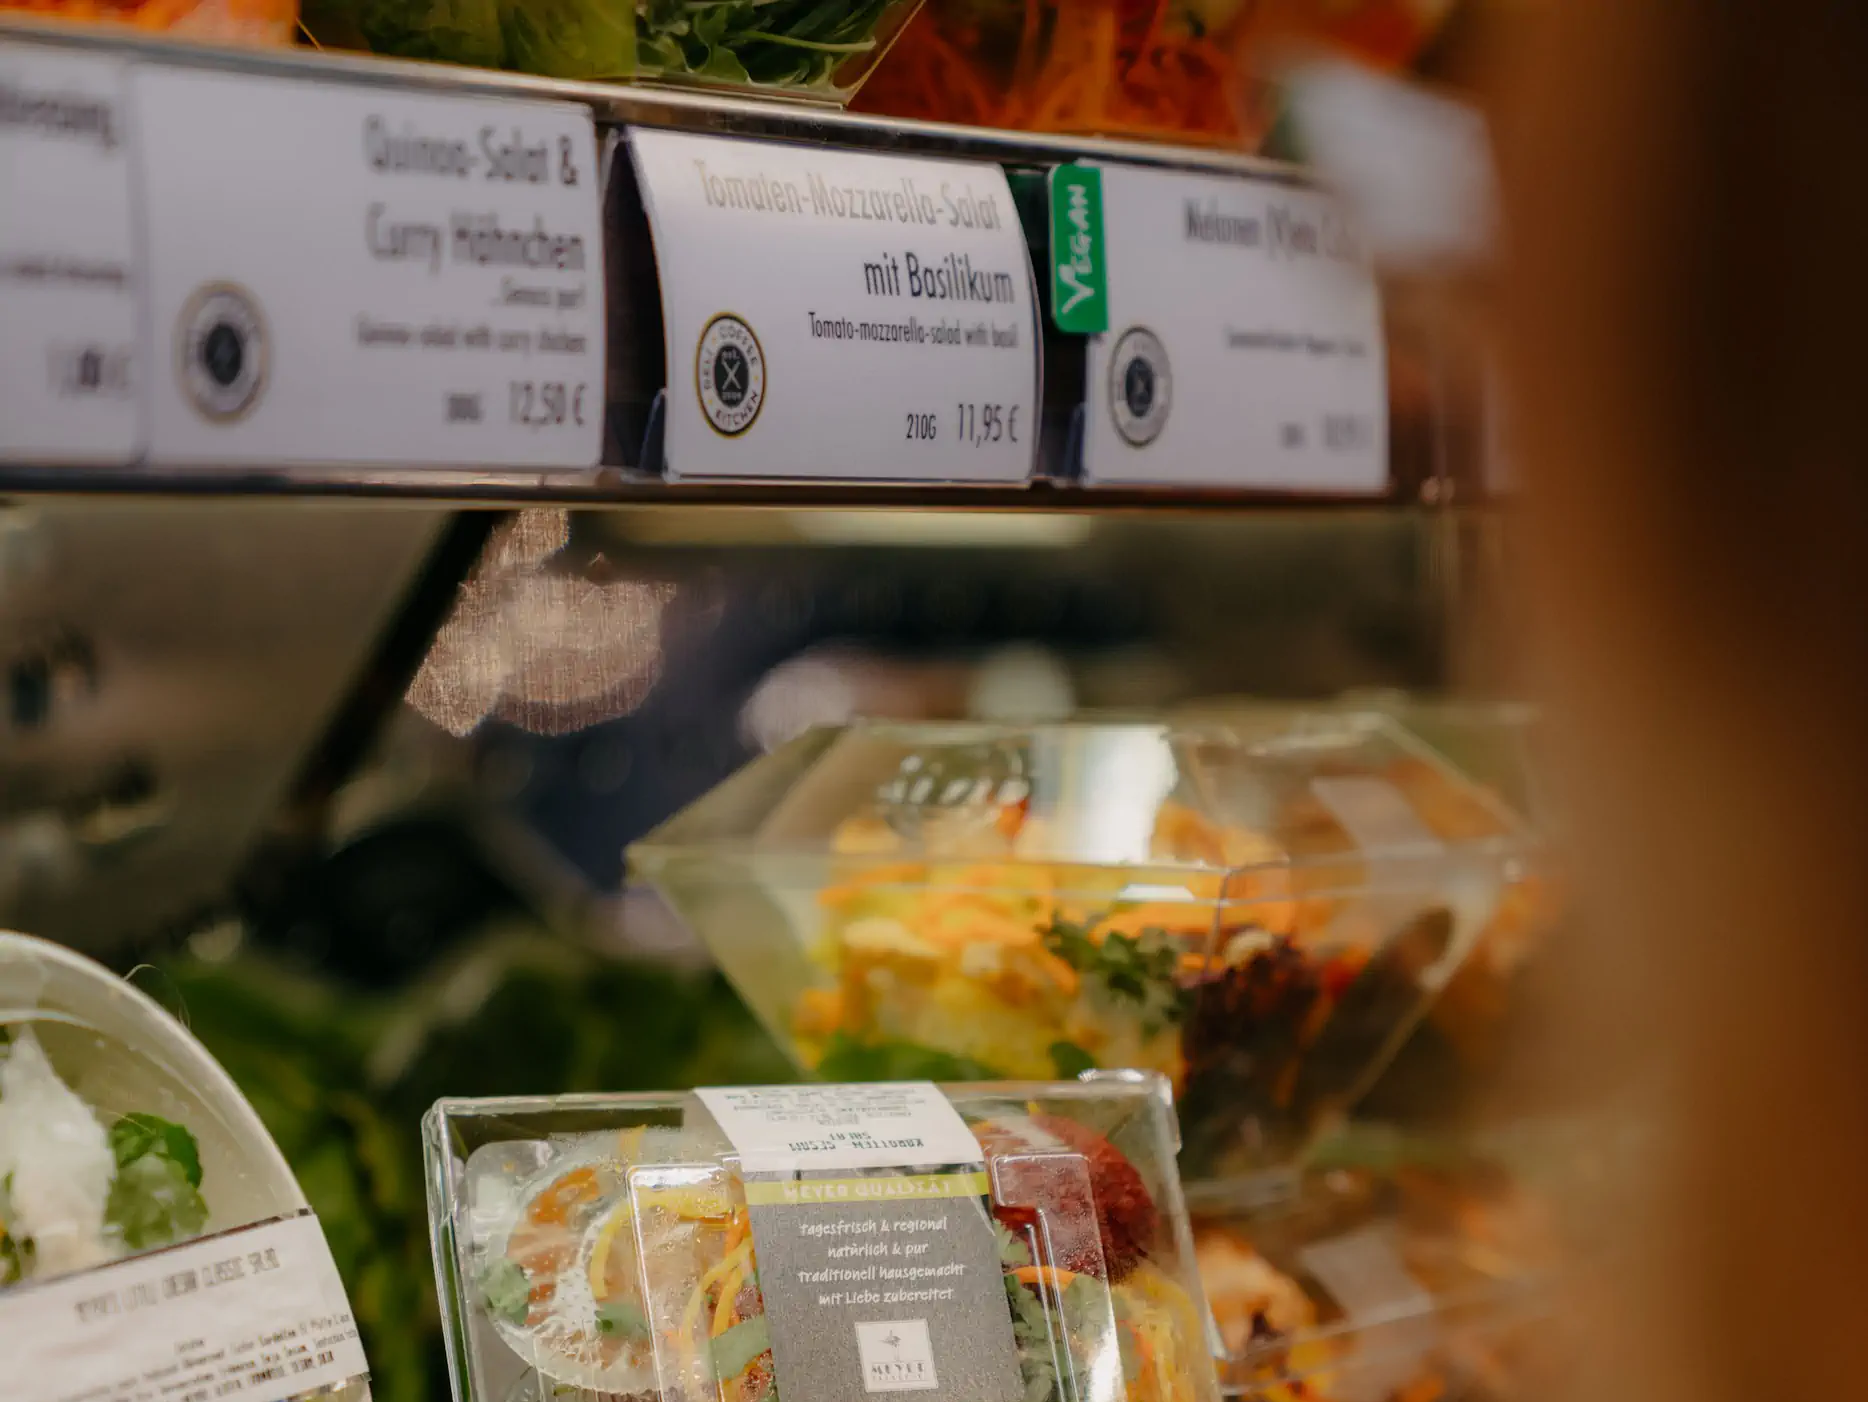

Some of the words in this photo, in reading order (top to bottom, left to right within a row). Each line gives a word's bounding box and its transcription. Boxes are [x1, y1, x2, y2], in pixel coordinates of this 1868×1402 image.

[694, 158, 1003, 229] Tomaten-Mozzarella-Salat
[364, 202, 441, 275] Curry
[1058, 184, 1095, 314] VEGAN
[863, 252, 900, 298] mit
[905, 251, 1015, 304] Basilikum
[808, 312, 961, 345] Tomato-mozzarella-salad
[906, 413, 937, 441] 210G
[957, 402, 1002, 448] 11,95
[1008, 402, 1020, 443] €
[799, 1219, 877, 1237] tagesfrisch
[880, 1220, 890, 1233] &
[893, 1216, 948, 1234] regional
[827, 1241, 888, 1258] natürlich
[892, 1243, 902, 1255] &
[905, 1242, 929, 1258] pur
[797, 1265, 876, 1283] traditionell
[879, 1261, 967, 1280] hausgemacht
[818, 1292, 844, 1305] mit
[846, 1289, 880, 1304] Liebe
[883, 1287, 954, 1304] zubereitet
